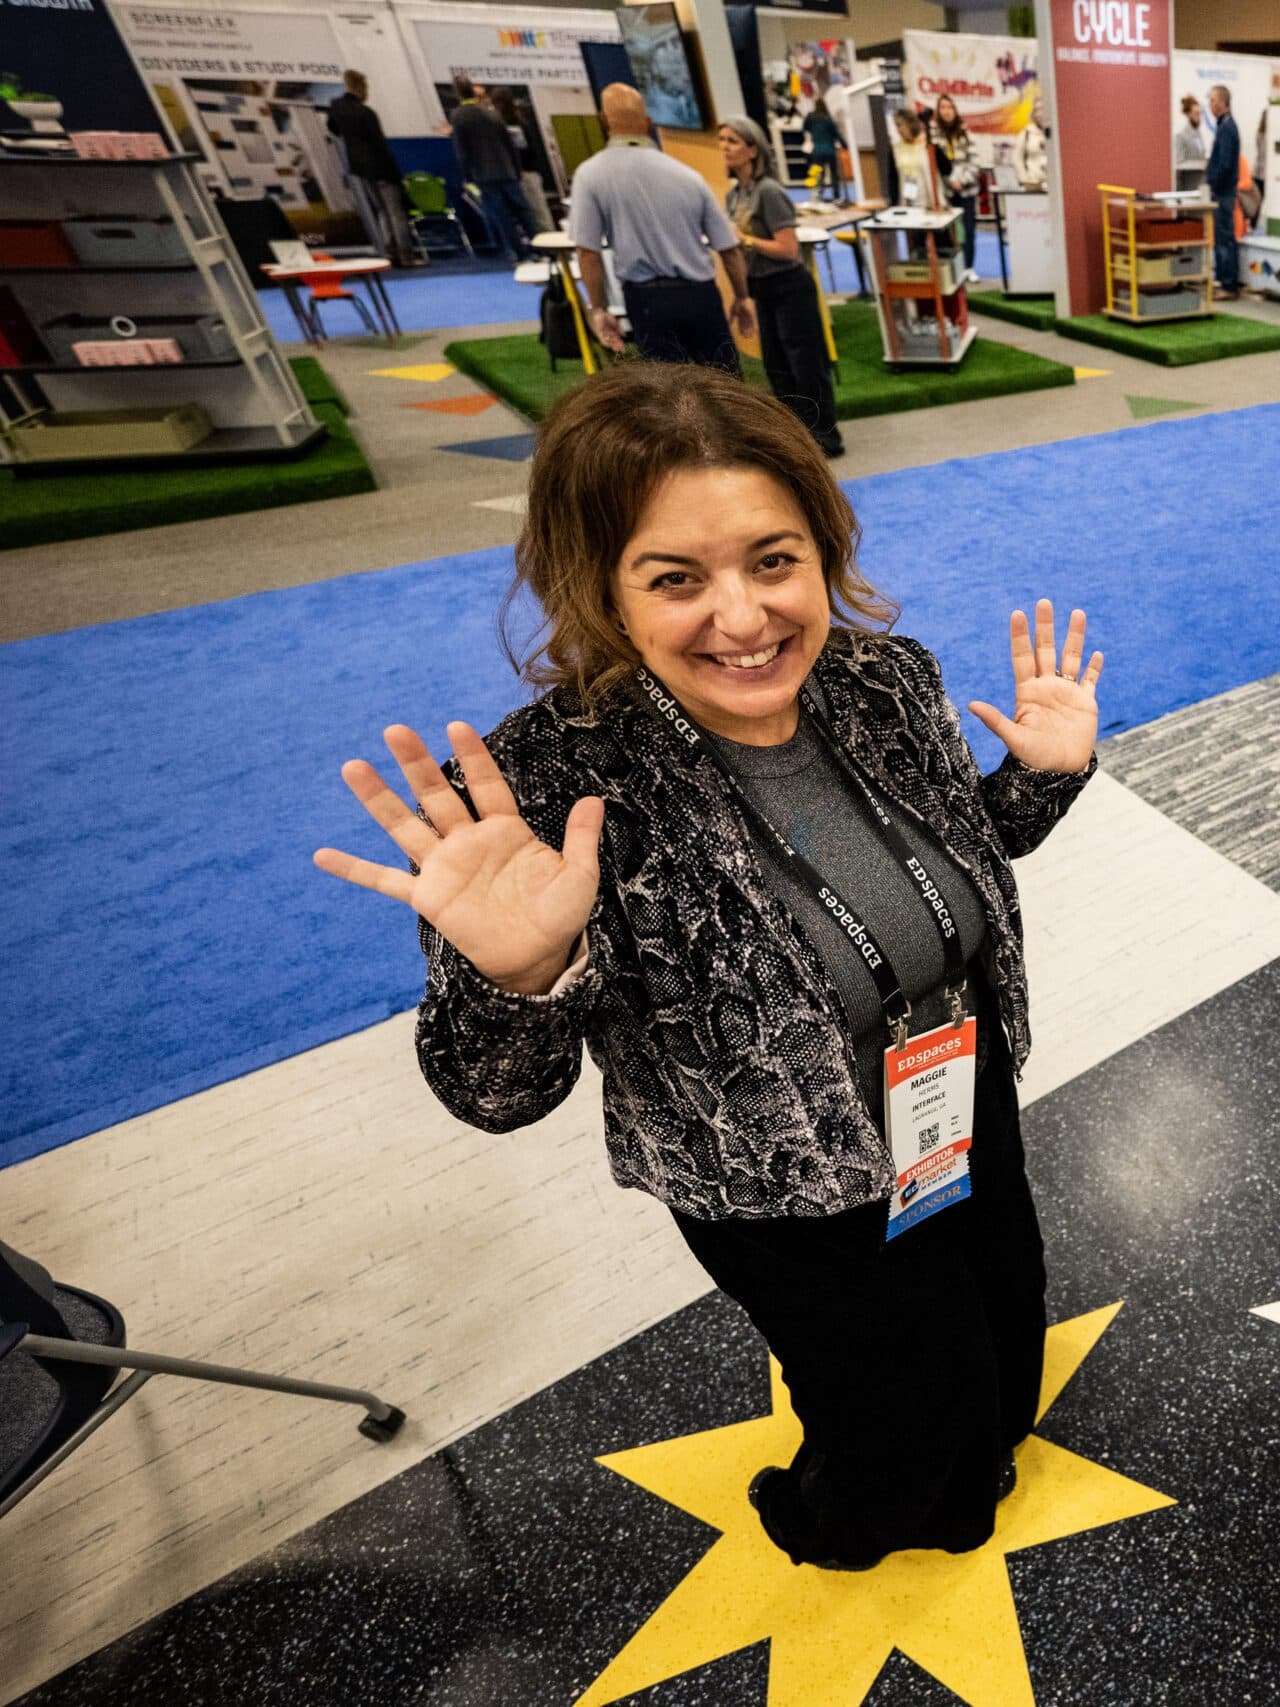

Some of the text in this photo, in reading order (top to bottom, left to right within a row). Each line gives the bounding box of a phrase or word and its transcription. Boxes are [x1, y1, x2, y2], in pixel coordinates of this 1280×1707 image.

[1073, 0, 1151, 47] CYCLE
[140, 57, 226, 73] DIVIDERS
[244, 61, 295, 75] STUDY
[906, 856, 956, 938] EDspaces
[818, 887, 882, 970] EDspaces
[897, 1037, 962, 1072] EDspaces
[911, 1066, 947, 1091] MAGGIE
[912, 1091, 946, 1112] INTERFACE
[906, 1146, 955, 1181] EXHIBITOR
